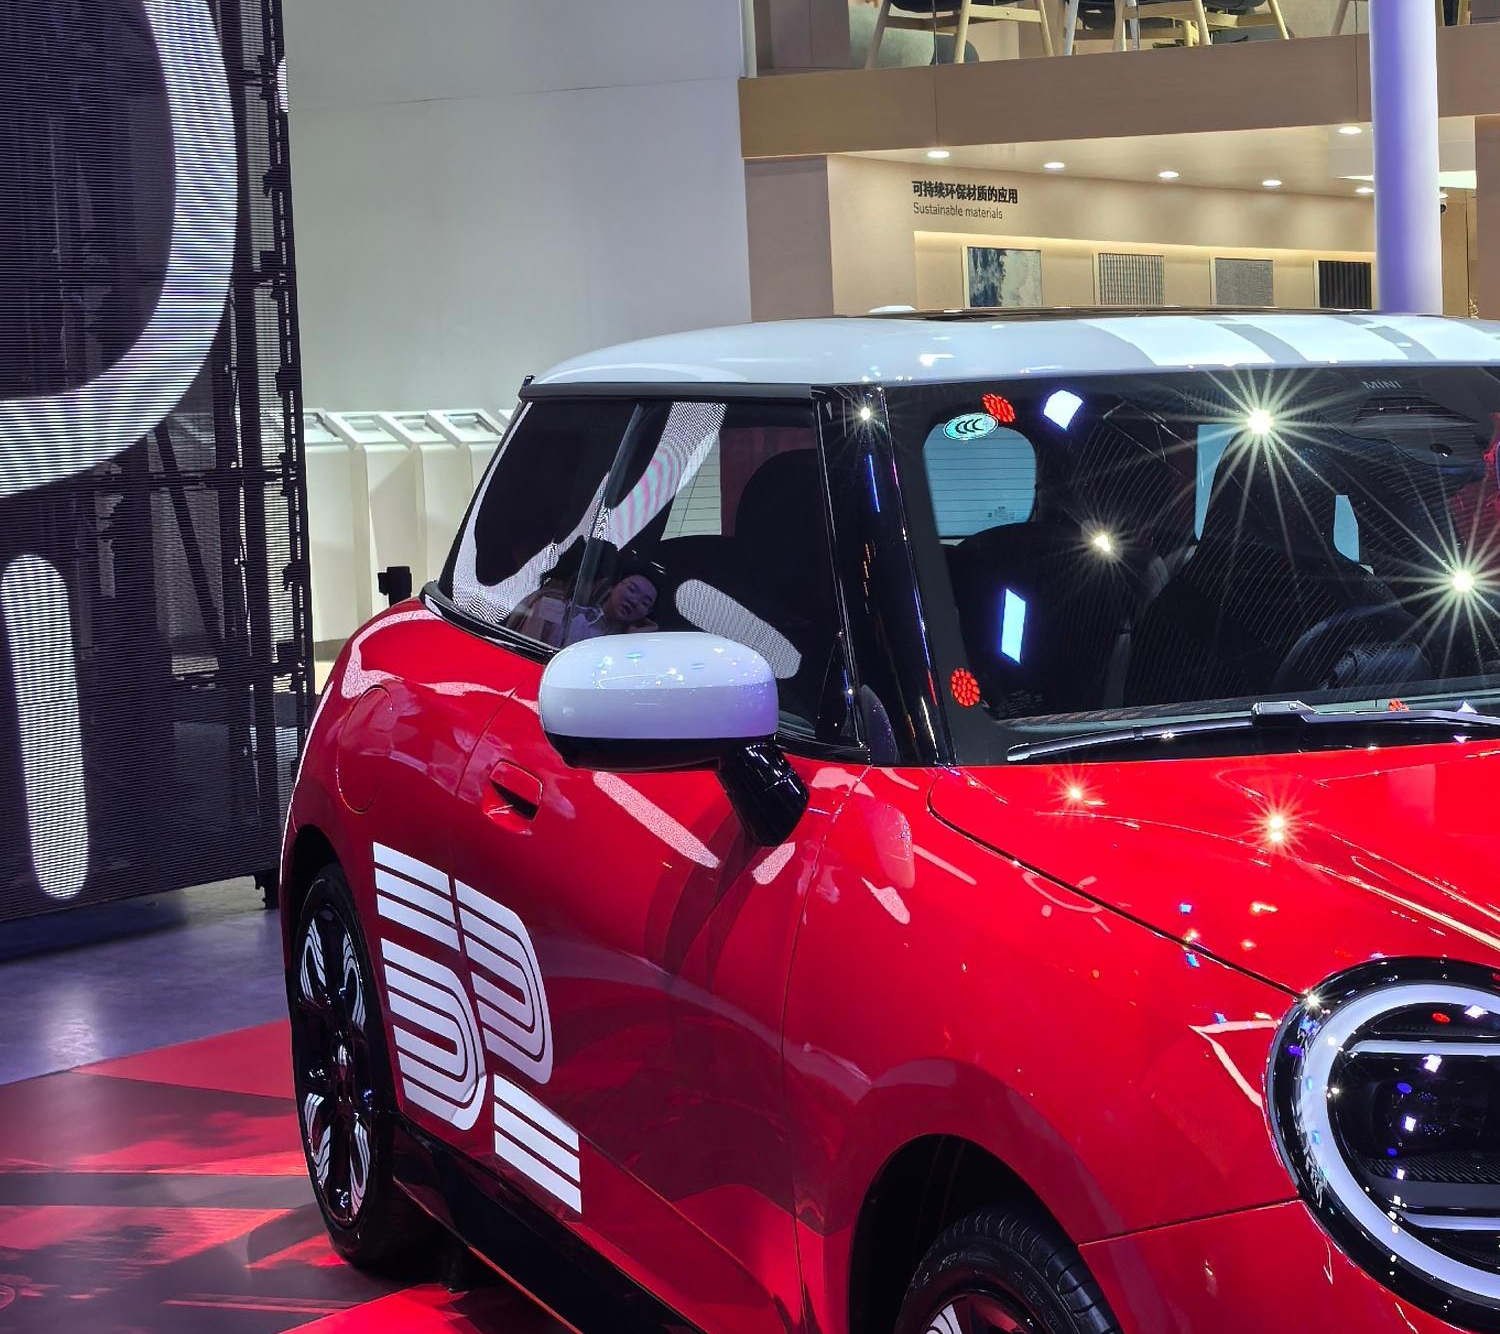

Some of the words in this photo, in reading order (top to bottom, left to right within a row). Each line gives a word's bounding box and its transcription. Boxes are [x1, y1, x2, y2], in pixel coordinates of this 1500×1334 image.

[911, 179, 1019, 205] 可持续环保材质的应用
[913, 201, 963, 217] Sustainable
[965, 207, 1003, 220] materials
